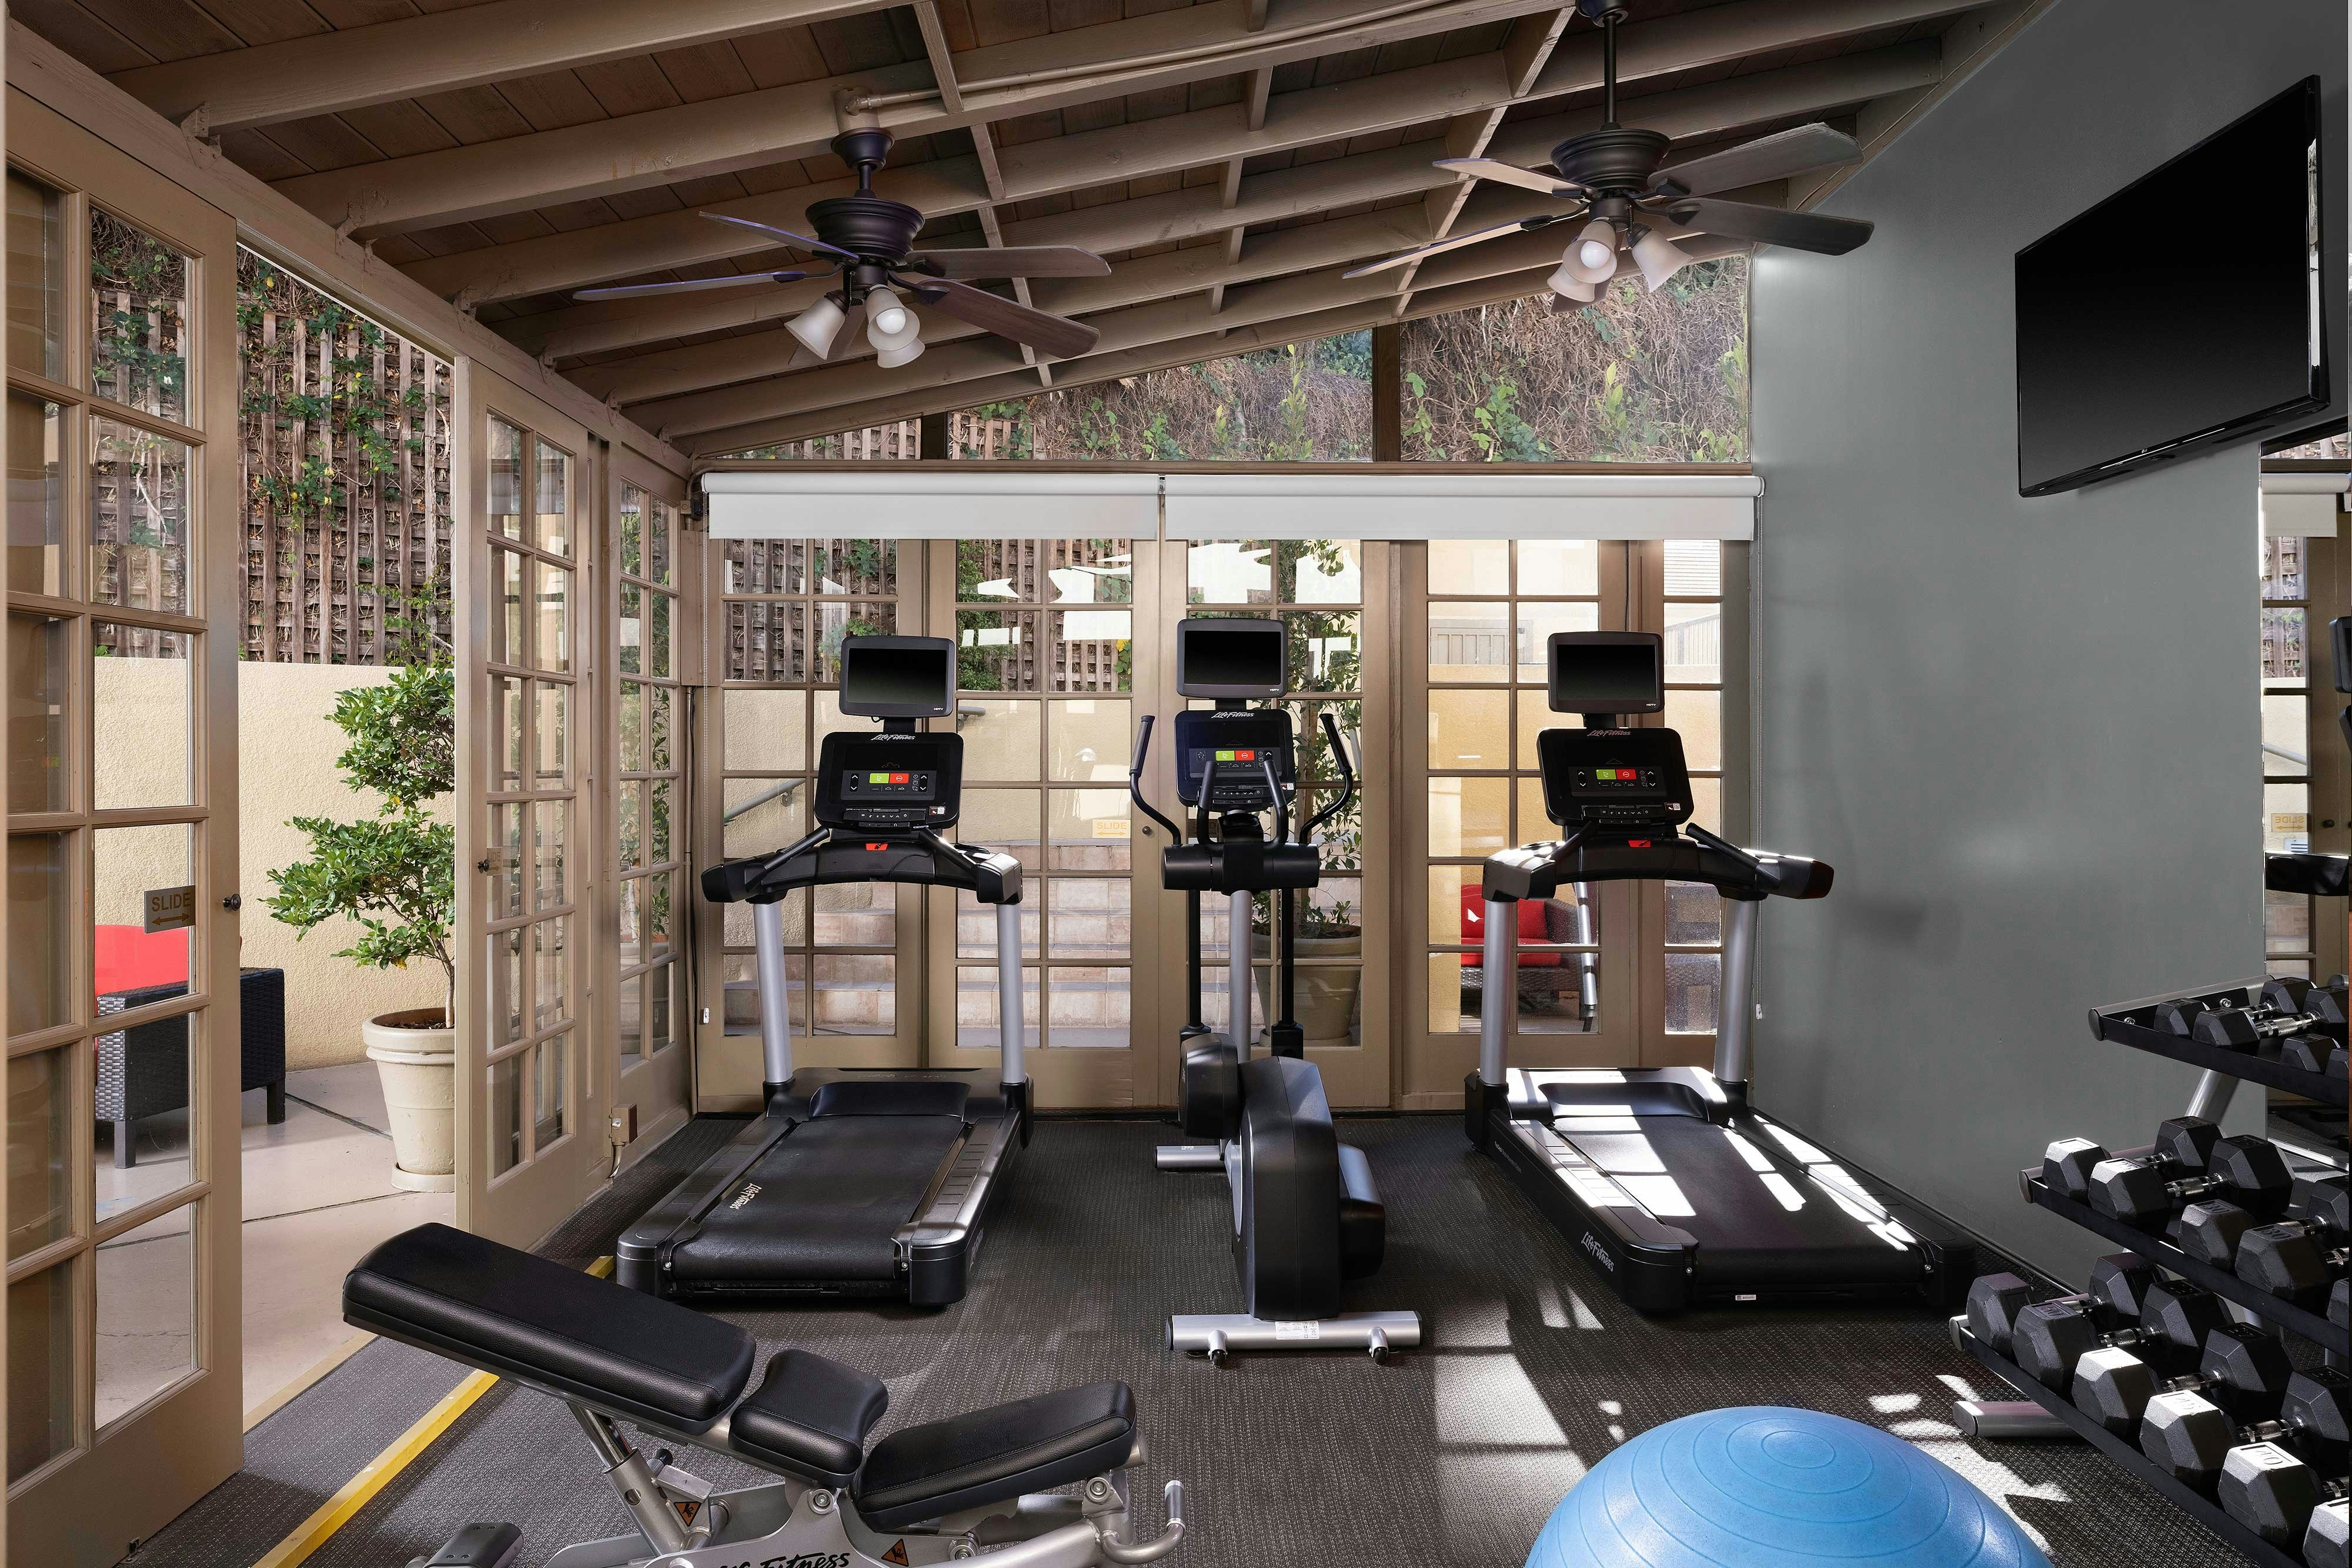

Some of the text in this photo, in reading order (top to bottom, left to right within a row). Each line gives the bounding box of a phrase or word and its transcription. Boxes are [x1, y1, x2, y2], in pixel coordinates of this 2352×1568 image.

[151, 892, 191, 912] SLIDE
[2203, 1204, 2230, 1214] 30
[2262, 1228, 2291, 1239] 30
